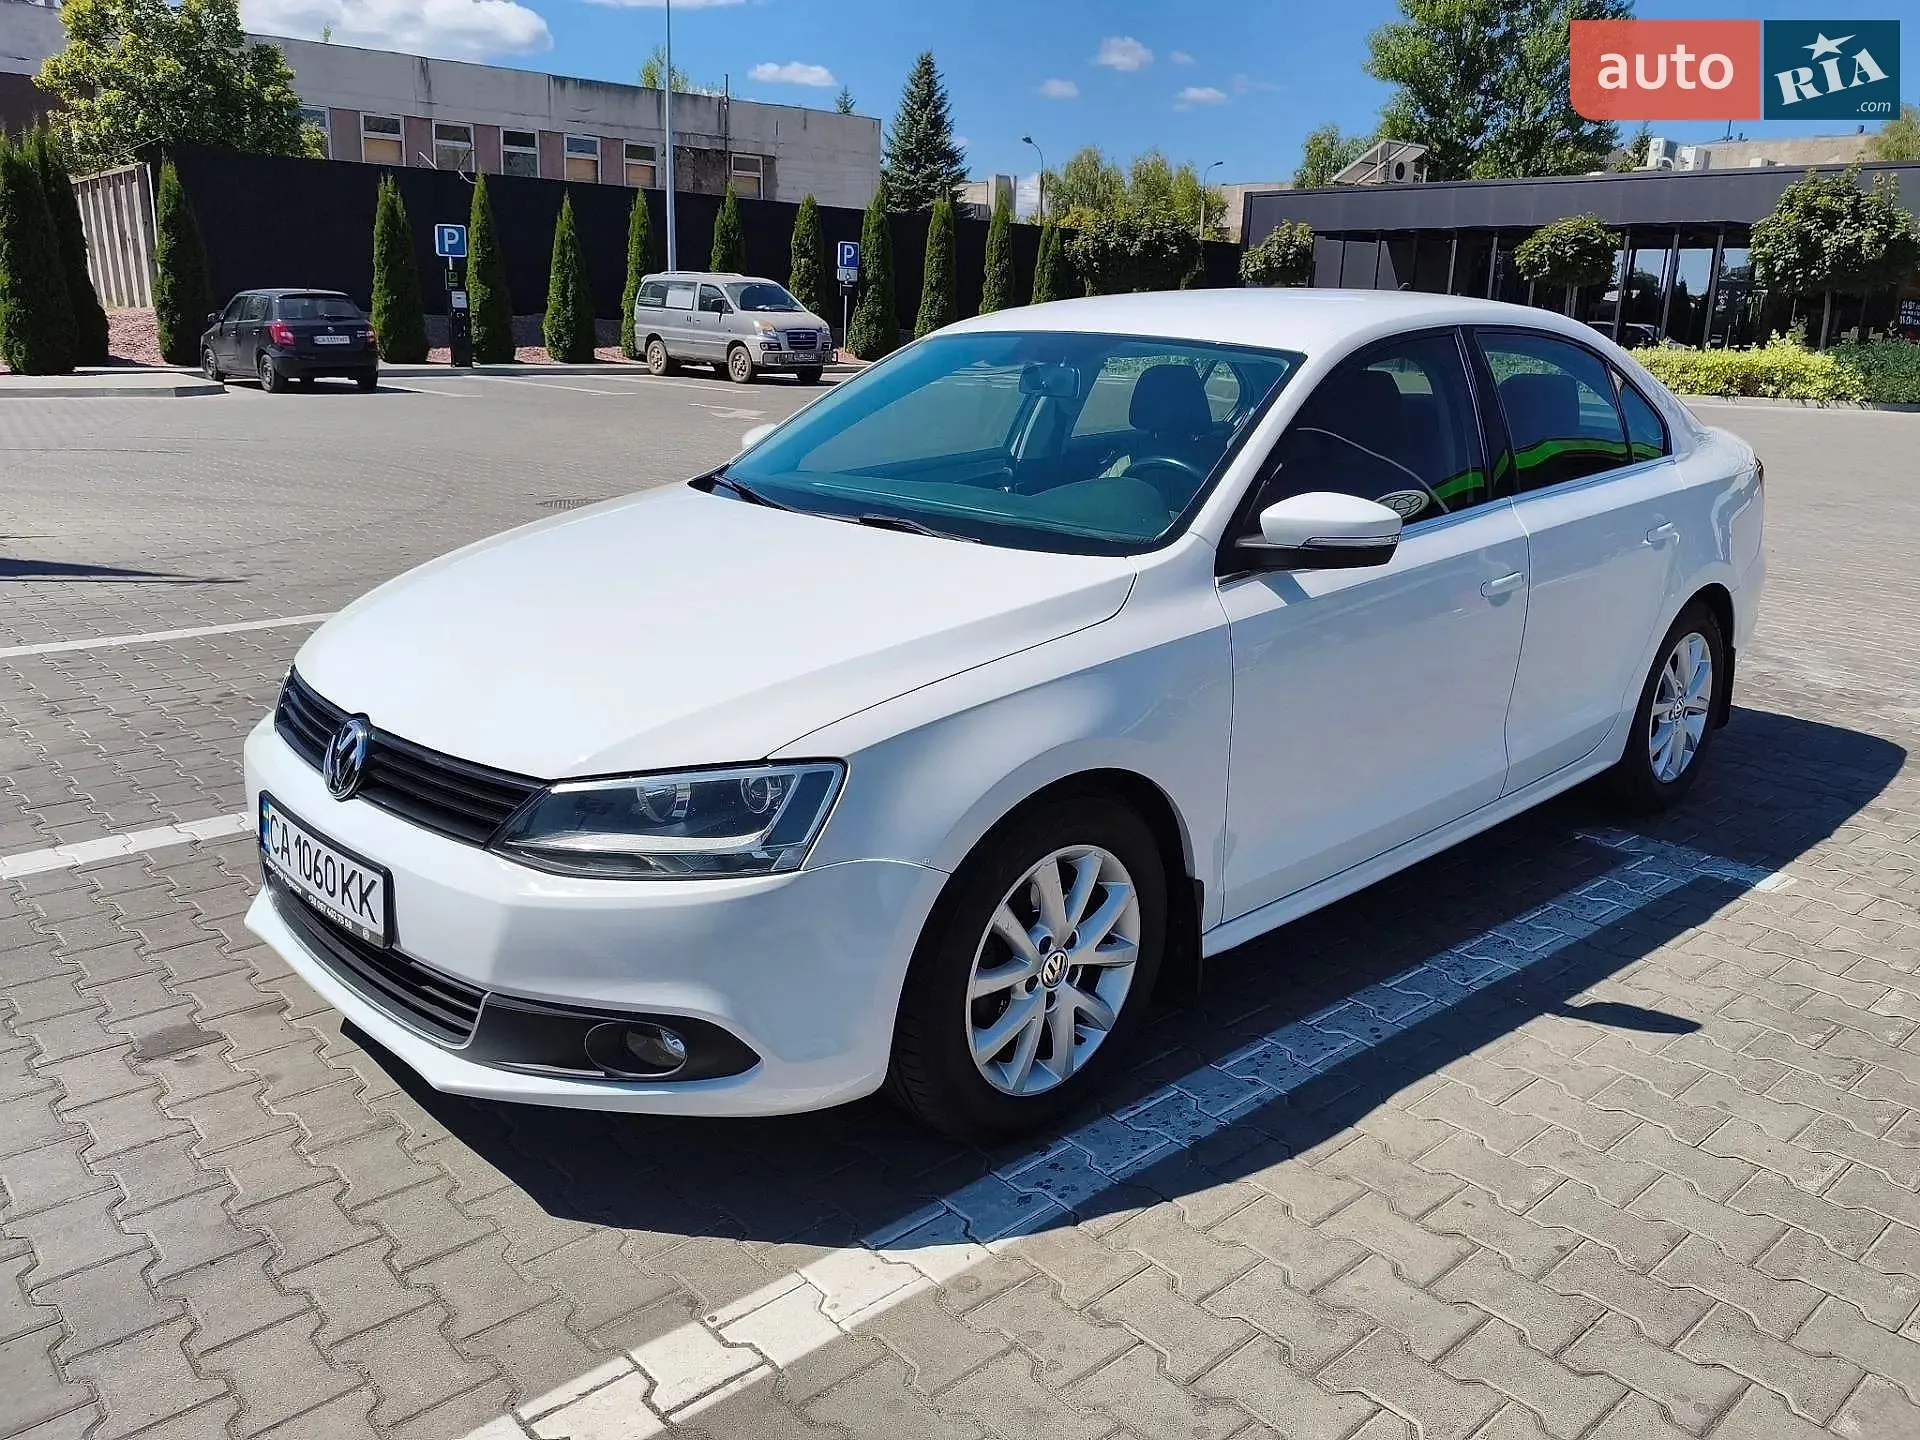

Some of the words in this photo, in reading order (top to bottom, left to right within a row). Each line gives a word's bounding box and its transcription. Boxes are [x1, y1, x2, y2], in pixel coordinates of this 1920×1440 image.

[444, 228, 459, 252] P
[844, 245, 854, 264] P
[270, 814, 291, 867] CA
[294, 834, 336, 898] 1060
[341, 863, 378, 925] KK
